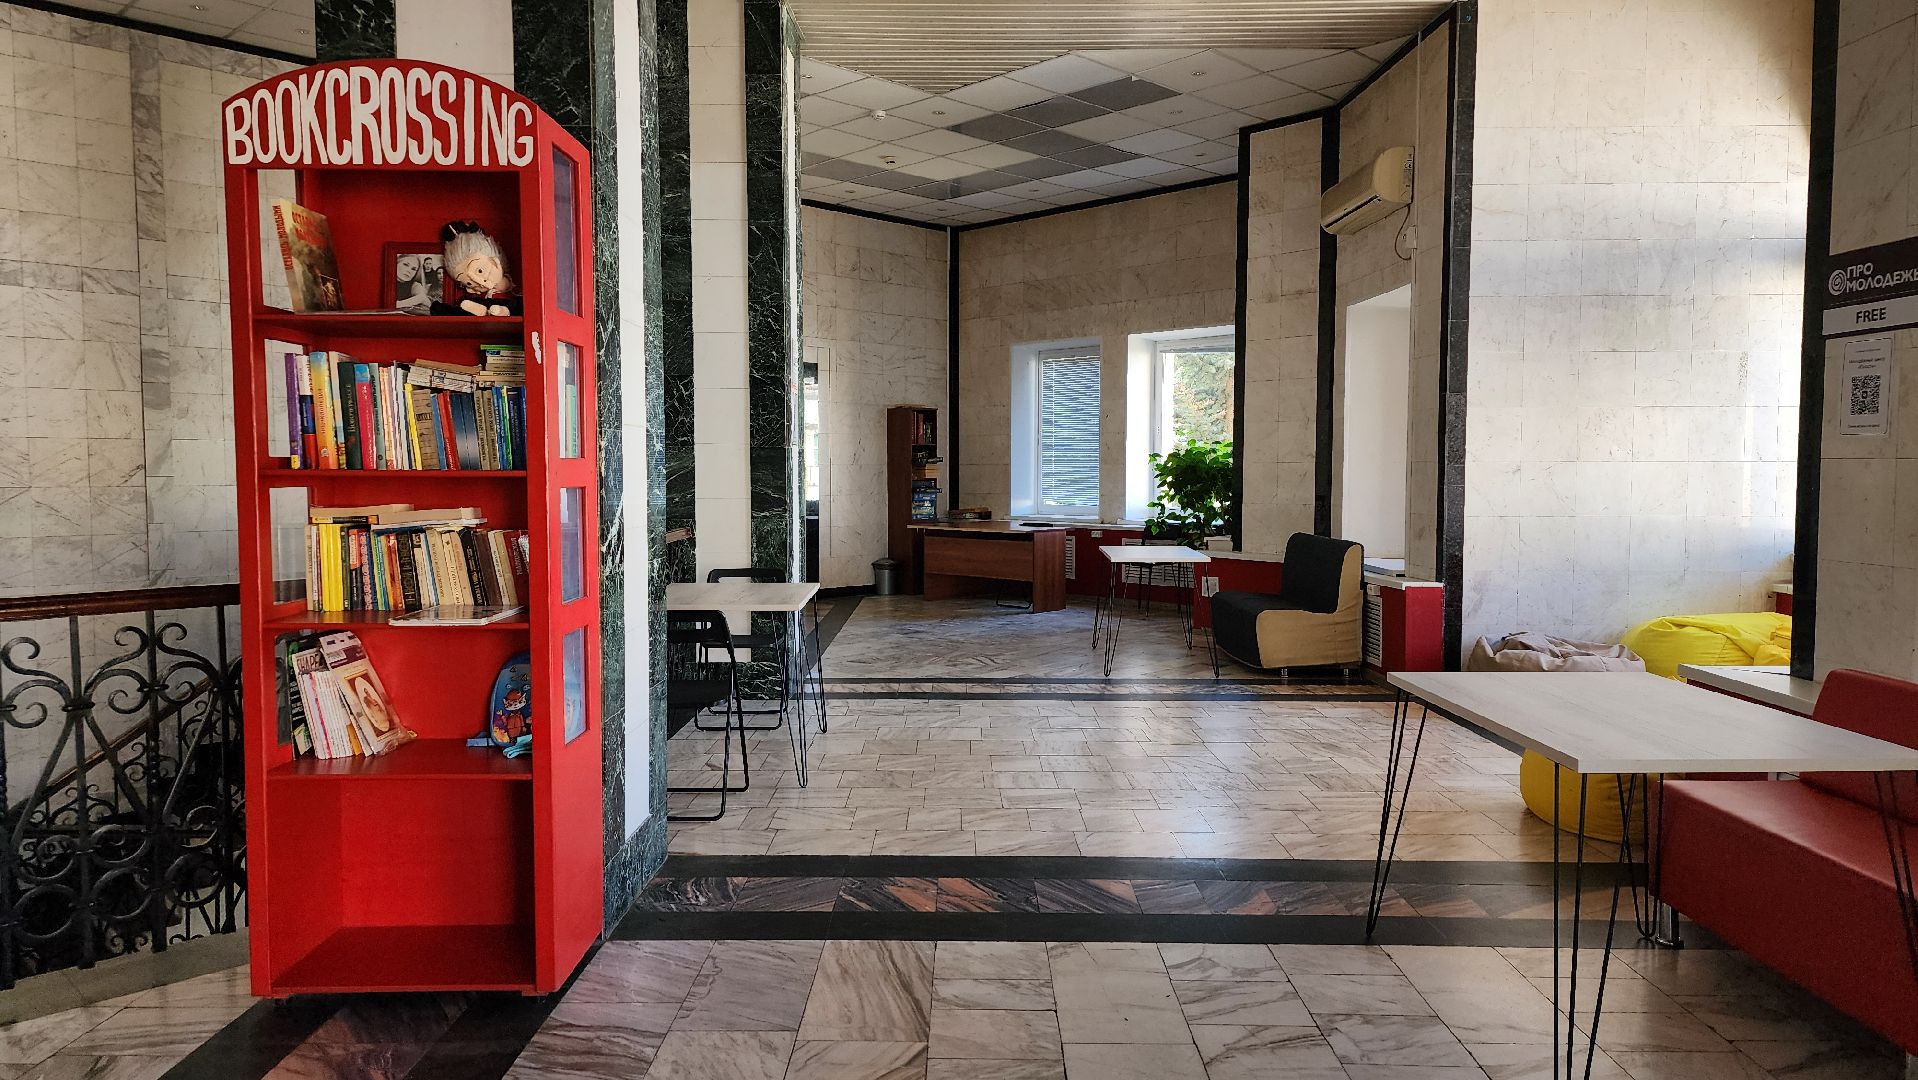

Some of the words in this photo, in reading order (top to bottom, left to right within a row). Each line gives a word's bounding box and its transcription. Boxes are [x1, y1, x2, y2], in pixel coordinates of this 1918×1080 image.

[225, 66, 534, 166] BOOKCROSSING
[1847, 262, 1874, 279] ПРО
[1855, 307, 1887, 324] FREE
